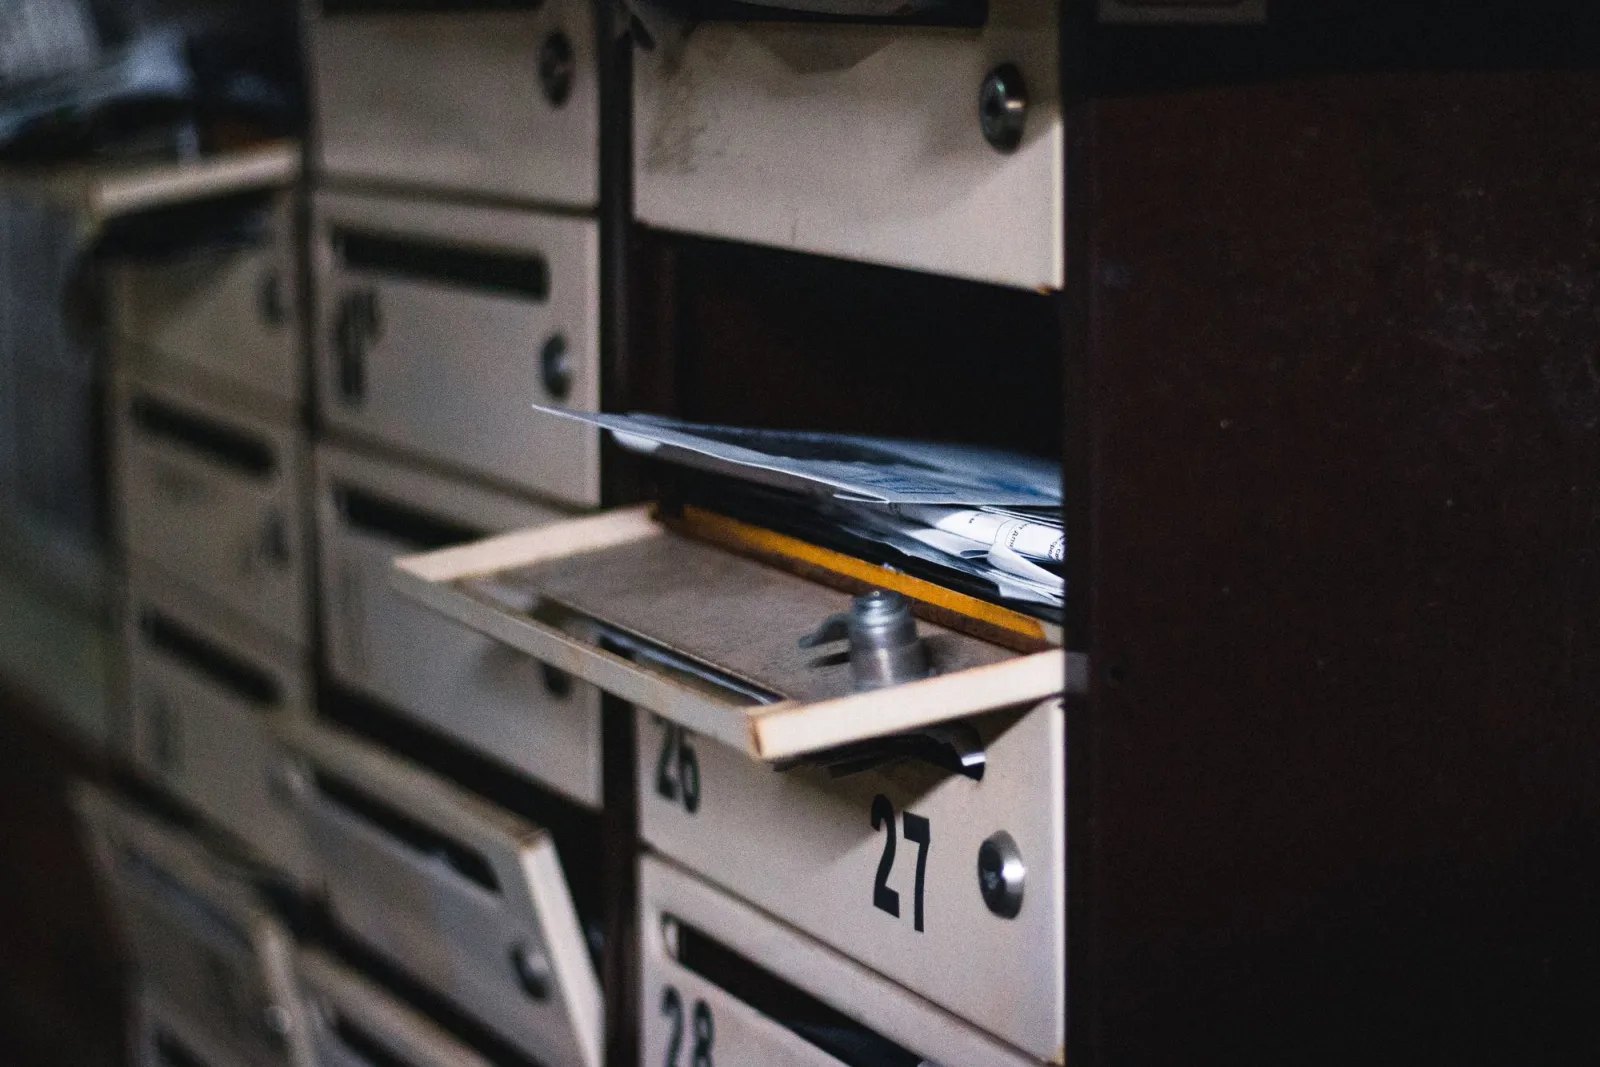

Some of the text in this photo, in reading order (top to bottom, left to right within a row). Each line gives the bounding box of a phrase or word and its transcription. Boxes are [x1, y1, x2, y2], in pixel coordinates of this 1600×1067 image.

[656, 714, 699, 813] 26
[871, 794, 930, 933] 27
[661, 984, 715, 1067] 28
